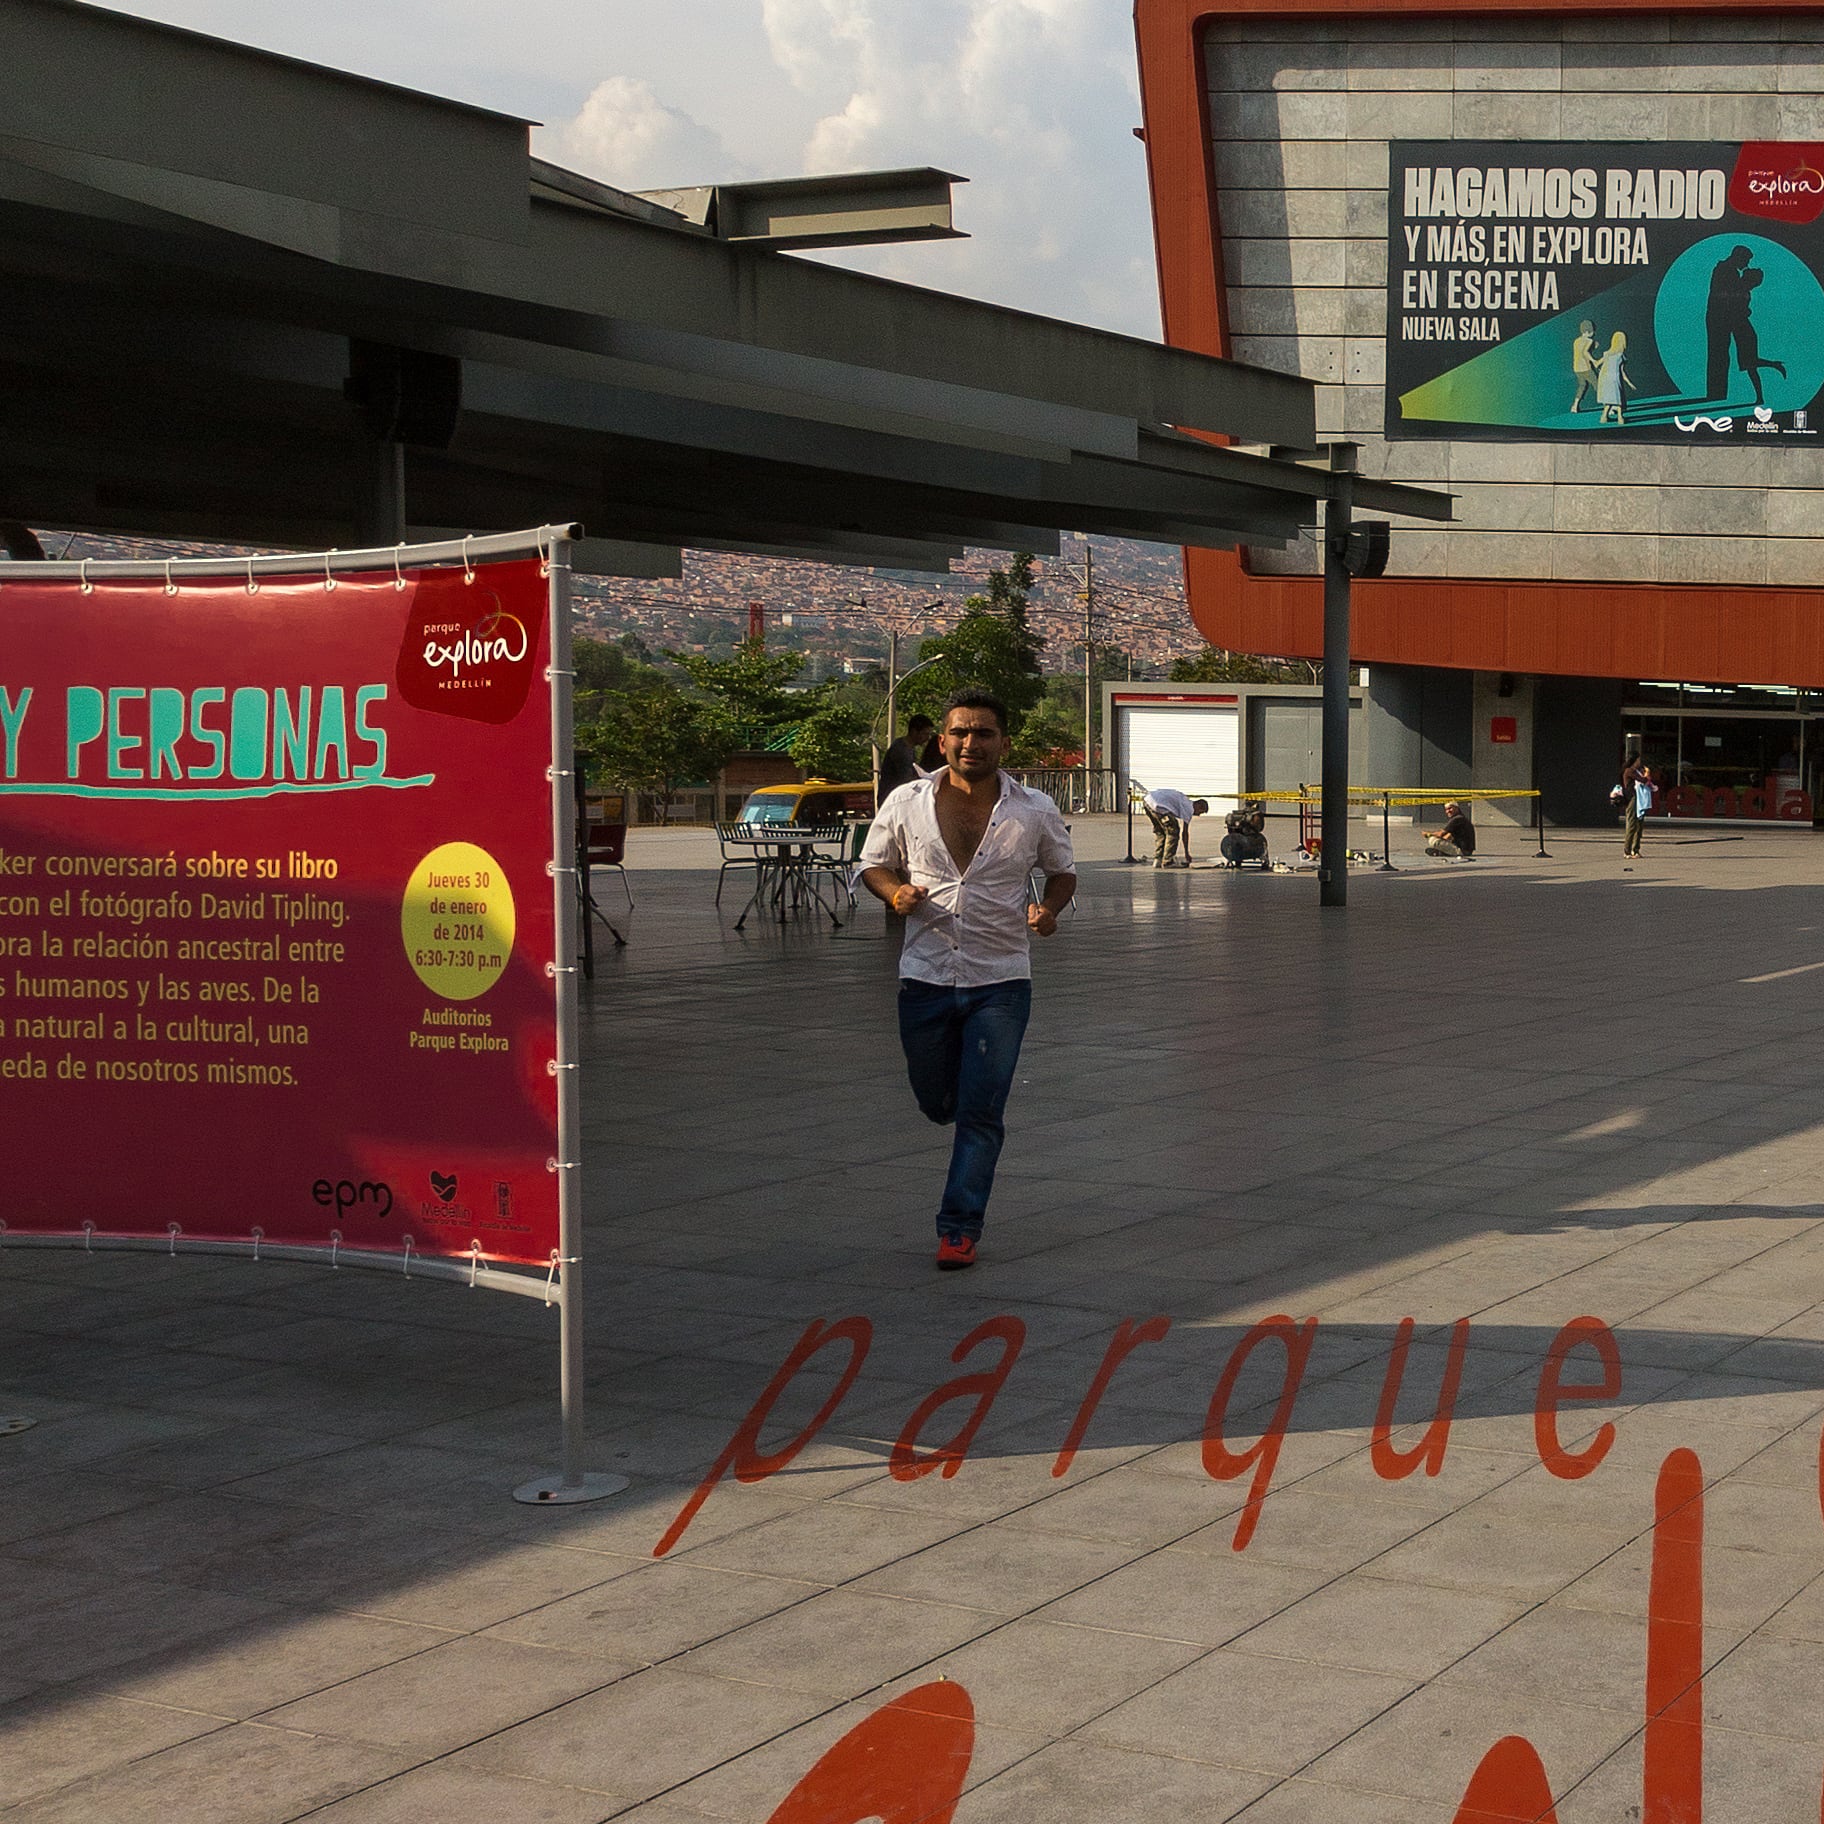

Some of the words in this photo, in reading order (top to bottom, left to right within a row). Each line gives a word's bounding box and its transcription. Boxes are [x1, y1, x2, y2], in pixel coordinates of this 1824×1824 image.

[1403, 166, 1599, 219] HAGAMOS
[1604, 168, 1726, 221] RADIO
[1748, 168, 1824, 199] explora
[1403, 225, 1419, 264] Y
[1426, 219, 1491, 270] MÁS,
[1492, 226, 1525, 265] EN
[1532, 226, 1649, 266] EXPLORA
[1402, 269, 1437, 310] EN
[1447, 269, 1560, 311] ESCENA
[1401, 317, 1456, 342] NUEVA
[1458, 316, 1501, 342] SALA
[423, 612, 528, 677] explora
[0, 685, 34, 779] Y
[66, 683, 388, 780] PERSONAS
[45, 850, 178, 878] conversará
[185, 850, 249, 879] sobre
[255, 857, 281, 879] su
[288, 850, 339, 880] libro
[427, 872, 471, 889] Jueves
[474, 871, 490, 889] 30
[49, 889, 71, 917] el
[79, 889, 193, 925] fotógrafo
[201, 892, 265, 920] David
[271, 892, 351, 928] Tipling.
[430, 897, 446, 914] de
[450, 901, 487, 915] enero
[42, 929, 64, 957] la
[73, 931, 169, 959] relación
[177, 934, 281, 961] ancestral
[288, 938, 345, 963] entre
[433, 924, 449, 941] de
[453, 924, 484, 941] 2014
[415, 949, 474, 968] 6:30-7:30
[478, 953, 502, 972] p.m
[15, 969, 129, 1000] humanos
[136, 980, 150, 1007] y
[158, 972, 191, 1001] las
[198, 980, 256, 1002] aves.
[263, 976, 293, 1003] De
[300, 975, 320, 1003] la
[15, 1012, 104, 1040] natural
[113, 1020, 127, 1040] a
[136, 1013, 157, 1041] la
[166, 1014, 260, 1047] cultural,
[267, 1023, 309, 1045] una
[422, 1008, 492, 1027] Auditorios
[409, 1031, 456, 1053] Parque
[459, 1032, 509, 1054] Explora
[56, 1052, 87, 1080] de
[96, 1057, 199, 1083] nosotros
[207, 1057, 299, 1086] mismos.
[311, 1179, 394, 1219] epm
[653, 1314, 1621, 1558] parque
